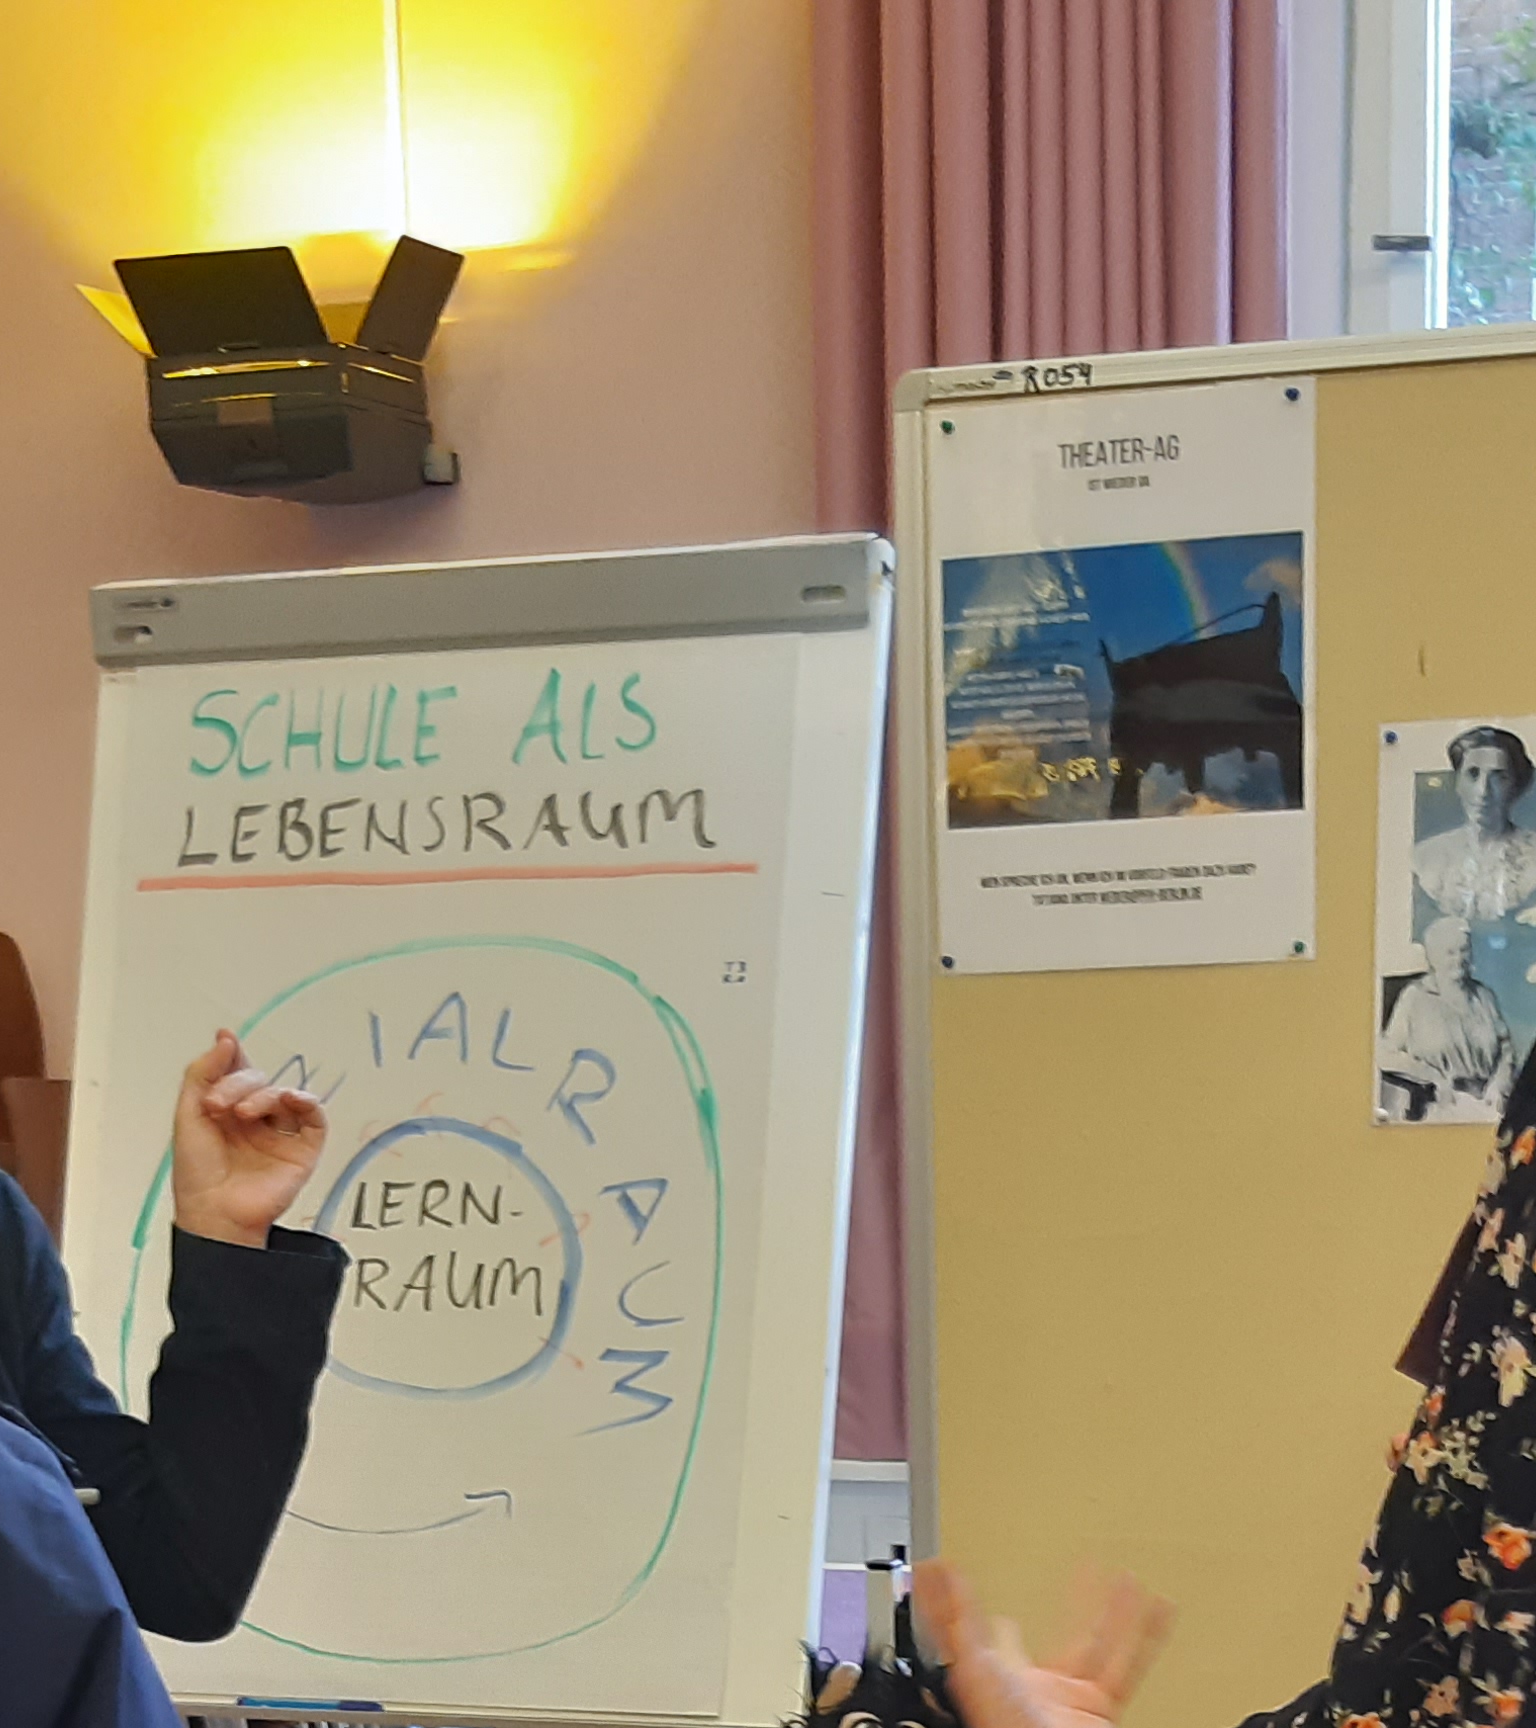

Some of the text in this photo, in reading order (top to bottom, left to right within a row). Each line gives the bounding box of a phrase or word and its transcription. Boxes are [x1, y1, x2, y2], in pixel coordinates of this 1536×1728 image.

[1058, 434, 1181, 469] THEATER-AG
[189, 667, 657, 779] SCHULE ALS
[177, 787, 720, 869] LEBENSRAUM
[350, 1179, 524, 1232] LERN-
[353, 1250, 544, 1317] RAUM
